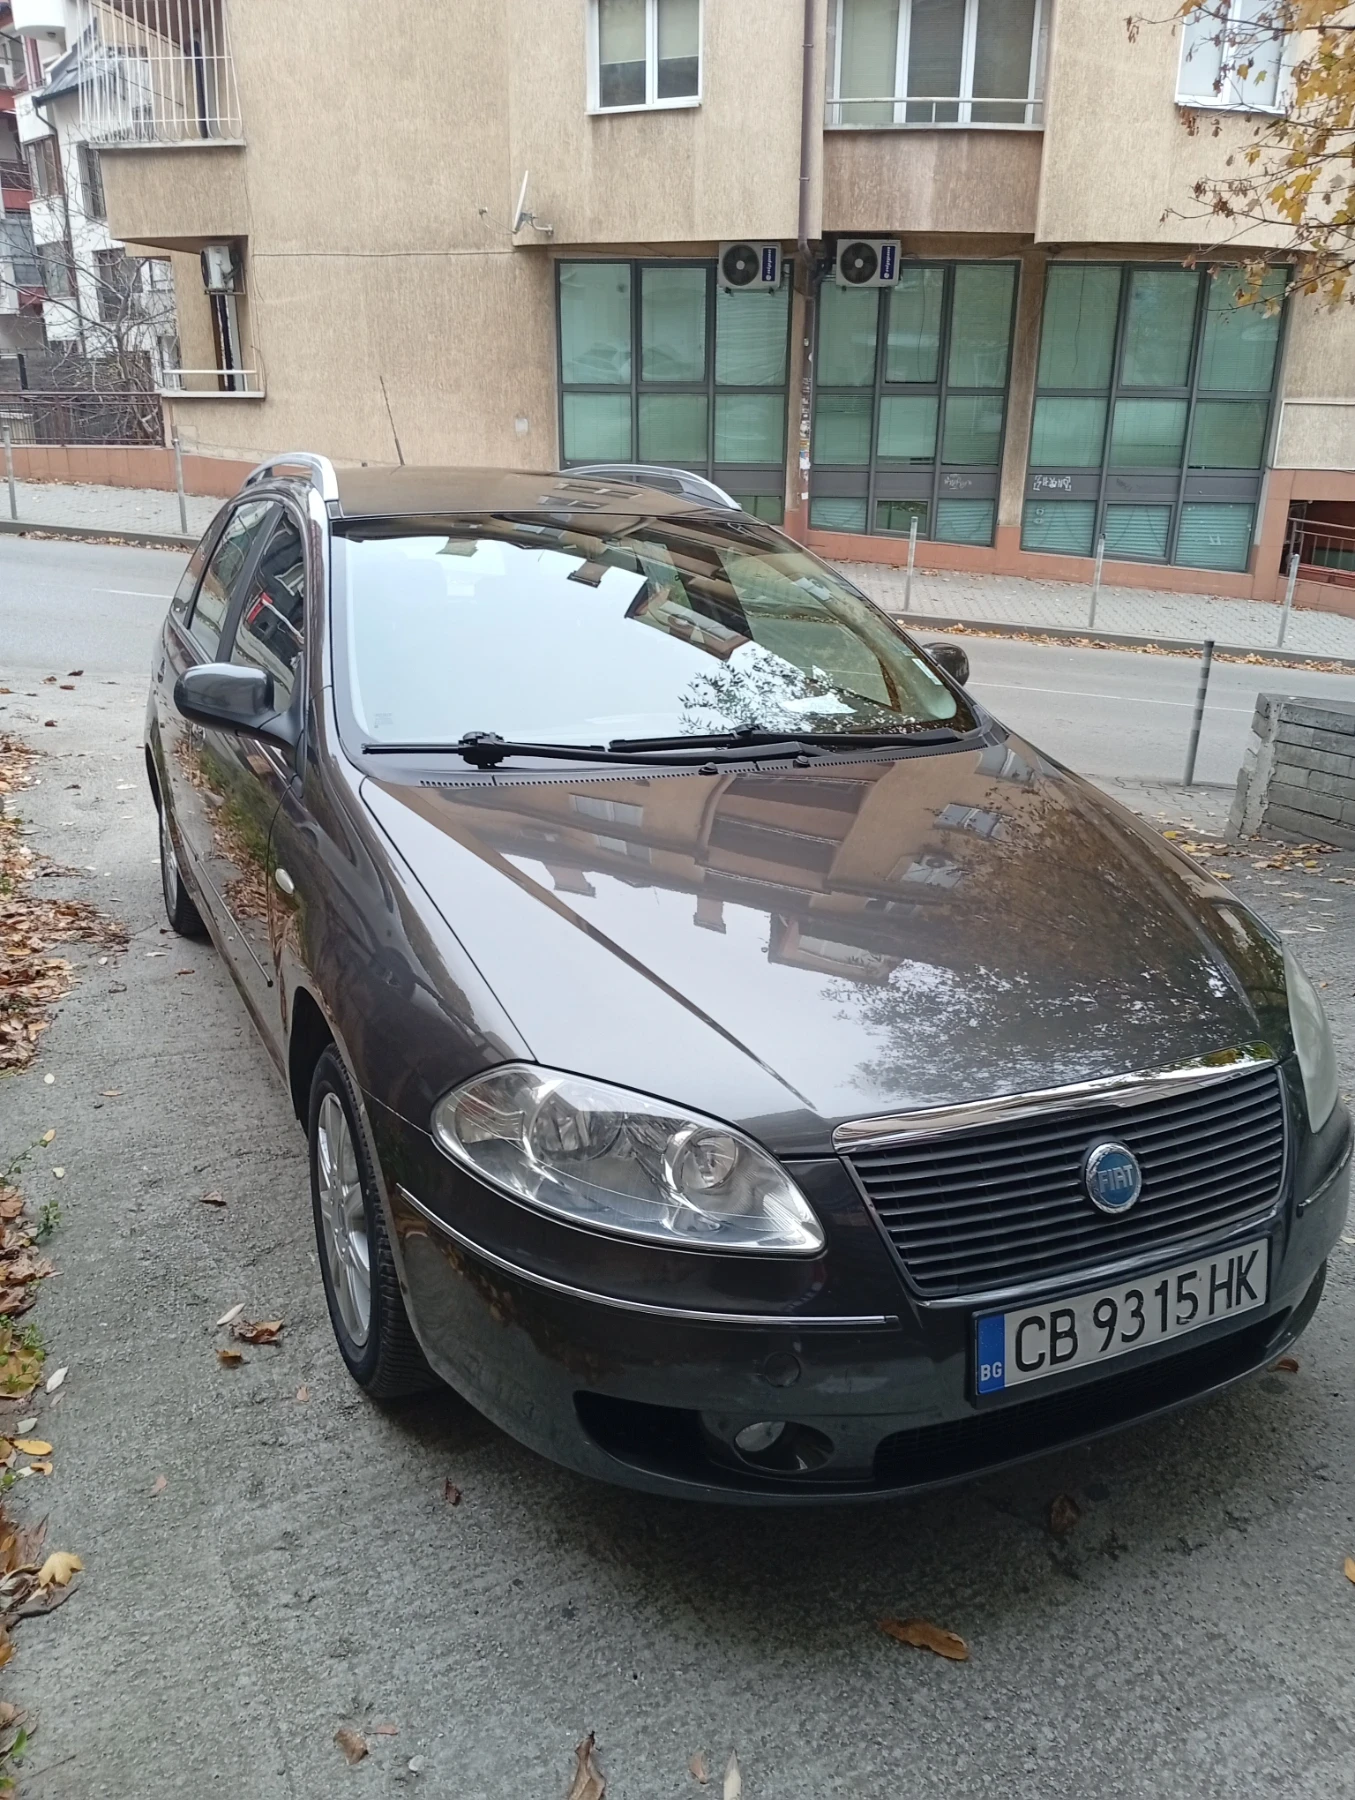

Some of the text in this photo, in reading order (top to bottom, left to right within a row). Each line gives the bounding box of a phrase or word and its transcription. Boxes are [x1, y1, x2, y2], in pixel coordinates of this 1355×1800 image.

[1098, 1164, 1133, 1193] FIAT
[1015, 1308, 1078, 1372] CB
[1093, 1270, 1199, 1352] 9315
[981, 1362, 1002, 1381] BG
